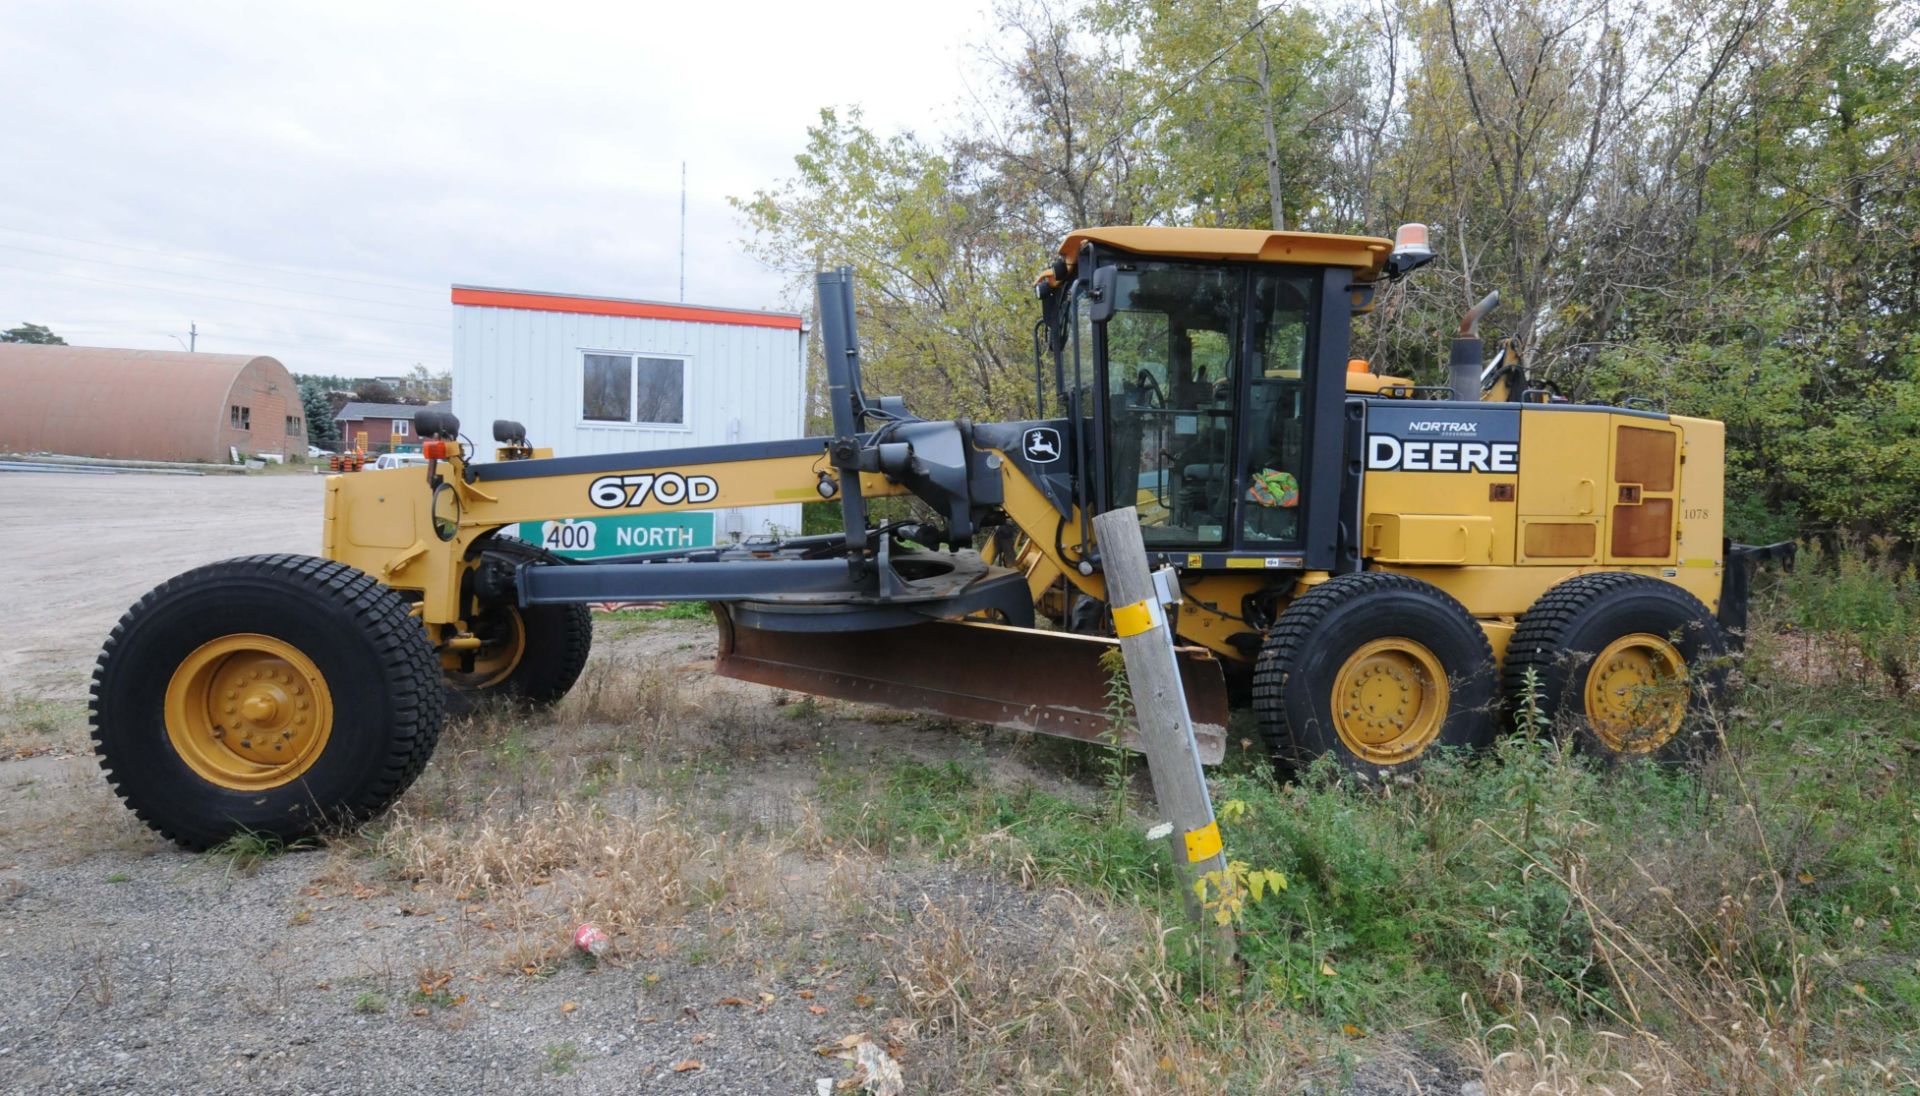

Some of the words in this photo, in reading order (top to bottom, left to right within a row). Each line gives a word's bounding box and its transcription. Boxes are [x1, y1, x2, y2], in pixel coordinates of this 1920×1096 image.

[1408, 421, 1478, 432] NORTRAX
[1367, 435, 1518, 472] DEERE
[588, 472, 718, 508] 670D
[1684, 508, 1709, 520] 1078
[546, 525, 590, 548] 400
[616, 527, 694, 546] NORTH
